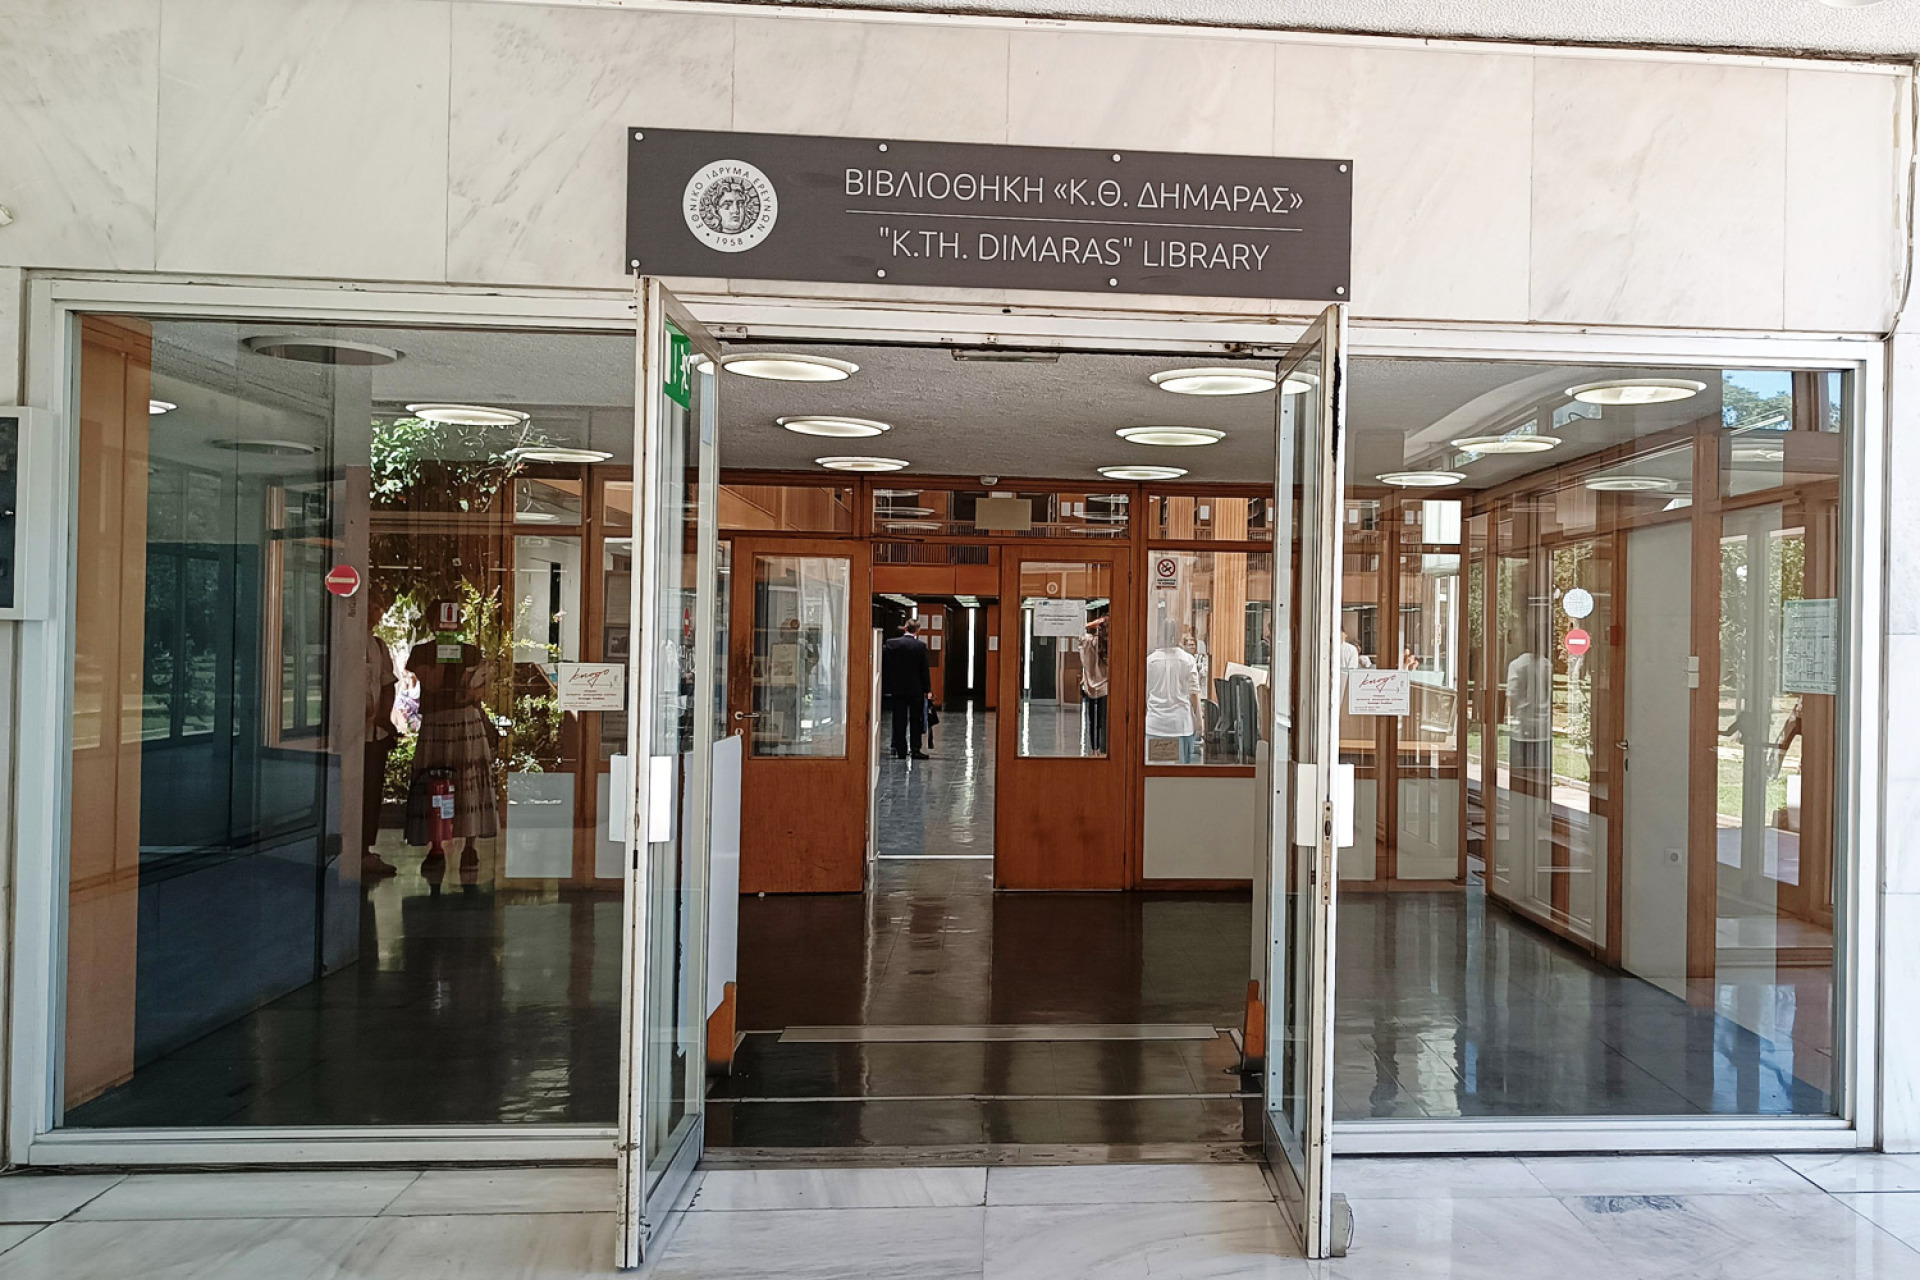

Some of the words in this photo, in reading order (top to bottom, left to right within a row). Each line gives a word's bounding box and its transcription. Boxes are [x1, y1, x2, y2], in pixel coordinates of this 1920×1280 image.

[690, 182, 704, 229] ΕΘΝΙΚΟ
[706, 167, 750, 180] ΙΔΡΥΜΑ
[753, 177, 772, 232] ΕΡΕΥΝΩΝ
[845, 168, 1044, 203] ΒΙΒΛΙΟΘΗΚΗ
[1053, 178, 1129, 208] «Κ.Θ.
[1137, 181, 1304, 214] ΔΗΜΑΡΑΣ»
[716, 236, 743, 247] 1958
[878, 226, 968, 259] "K.TH.
[978, 232, 1133, 266] DIMARAS"
[1143, 240, 1270, 271] LIBRARY
